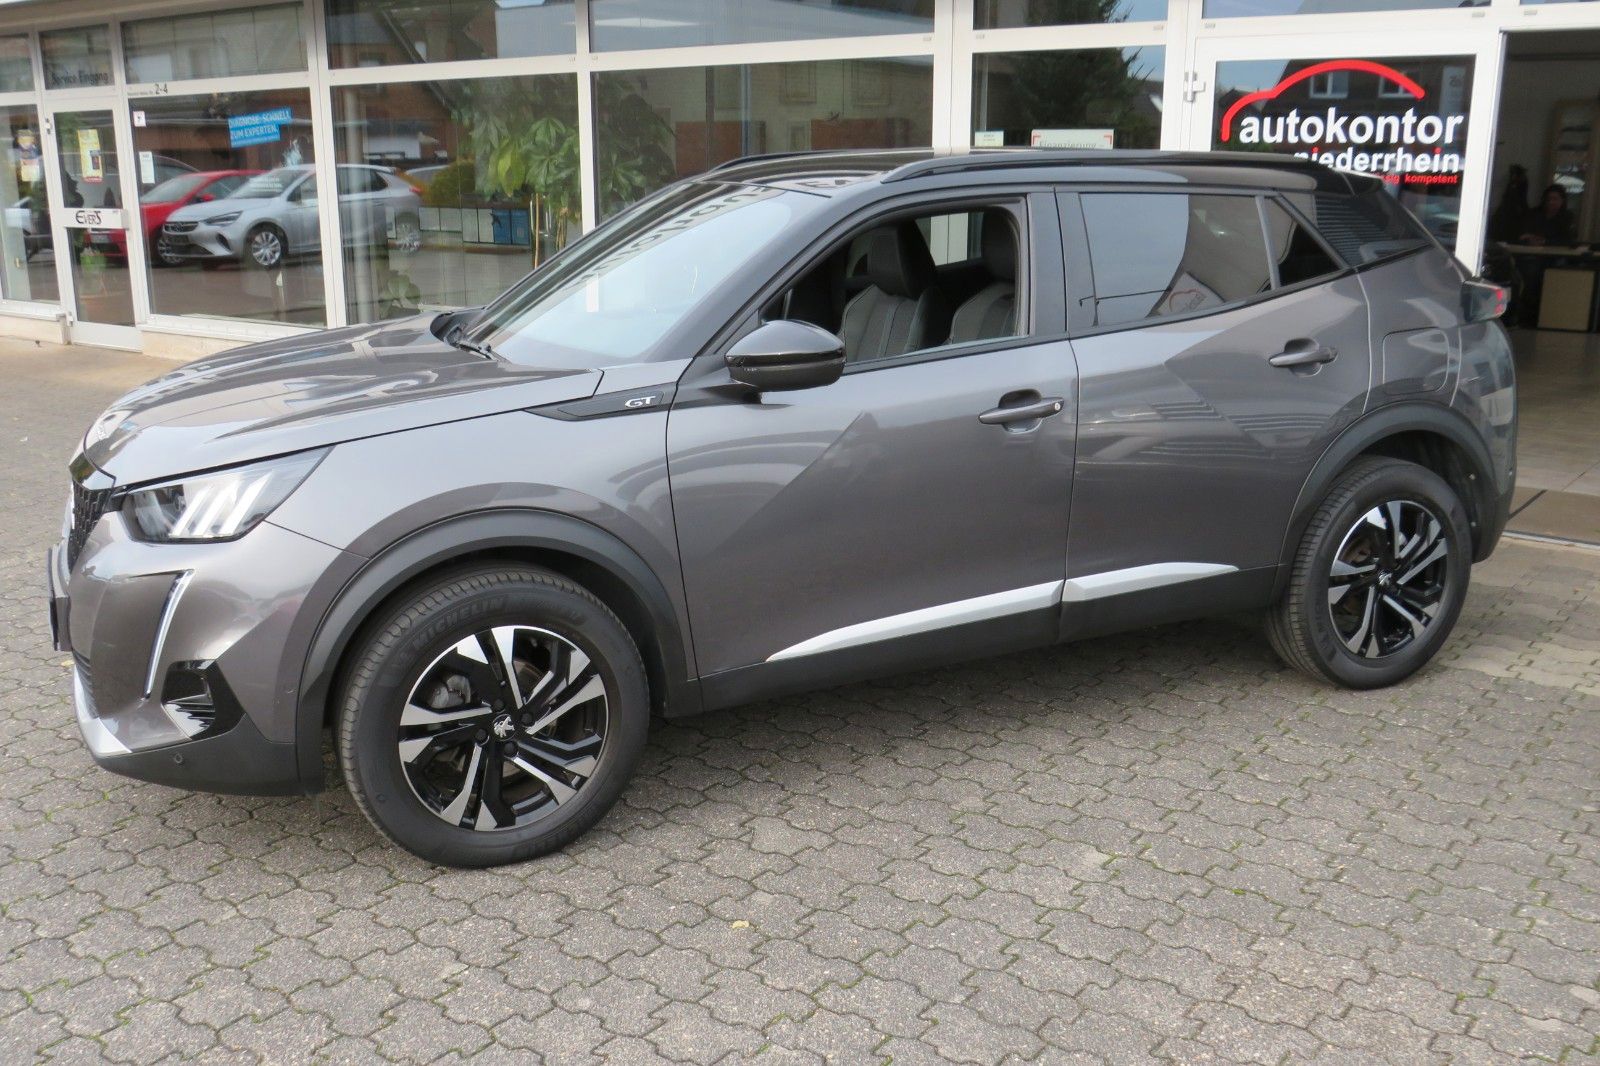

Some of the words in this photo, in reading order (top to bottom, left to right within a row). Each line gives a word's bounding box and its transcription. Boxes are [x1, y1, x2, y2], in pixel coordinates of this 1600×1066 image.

[154, 82, 168, 95] 2-4
[1239, 106, 1464, 144] autokontor
[1404, 173, 1458, 184] kompetent
[624, 396, 656, 408] GT
